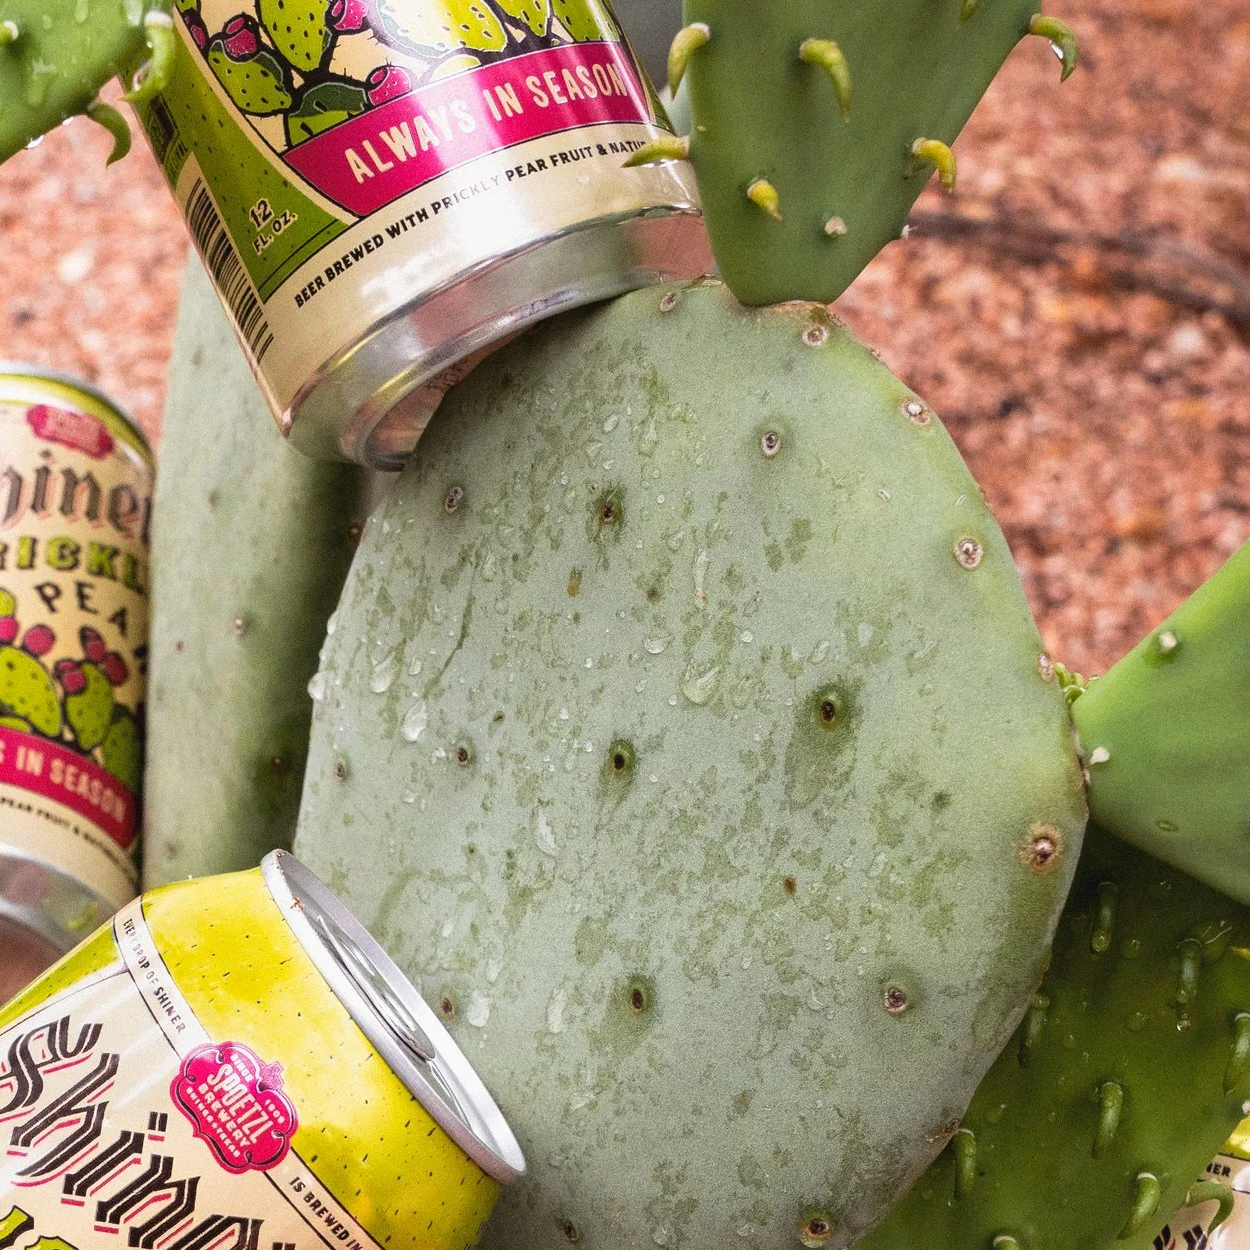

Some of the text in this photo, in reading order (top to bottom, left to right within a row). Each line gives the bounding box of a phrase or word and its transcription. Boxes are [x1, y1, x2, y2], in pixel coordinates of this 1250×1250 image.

[344, 63, 628, 185] ALWAYS IN SEASON
[249, 198, 274, 230] 12
[252, 210, 298, 254] FL. OZ.
[294, 140, 646, 309] BEER BREWED WITH PRICKLY PEAR FRUIT & NATU
[16, 745, 44, 777] IN
[49, 757, 127, 824] SEASON
[132, 943, 150, 969] DROP
[145, 970, 159, 986] OF
[153, 986, 186, 1035] SHINER
[198, 1082, 251, 1148] BREWERY
[207, 1063, 274, 1144] SPOETZL
[289, 1176, 306, 1193] IS
[303, 1190, 351, 1242] BREWED
